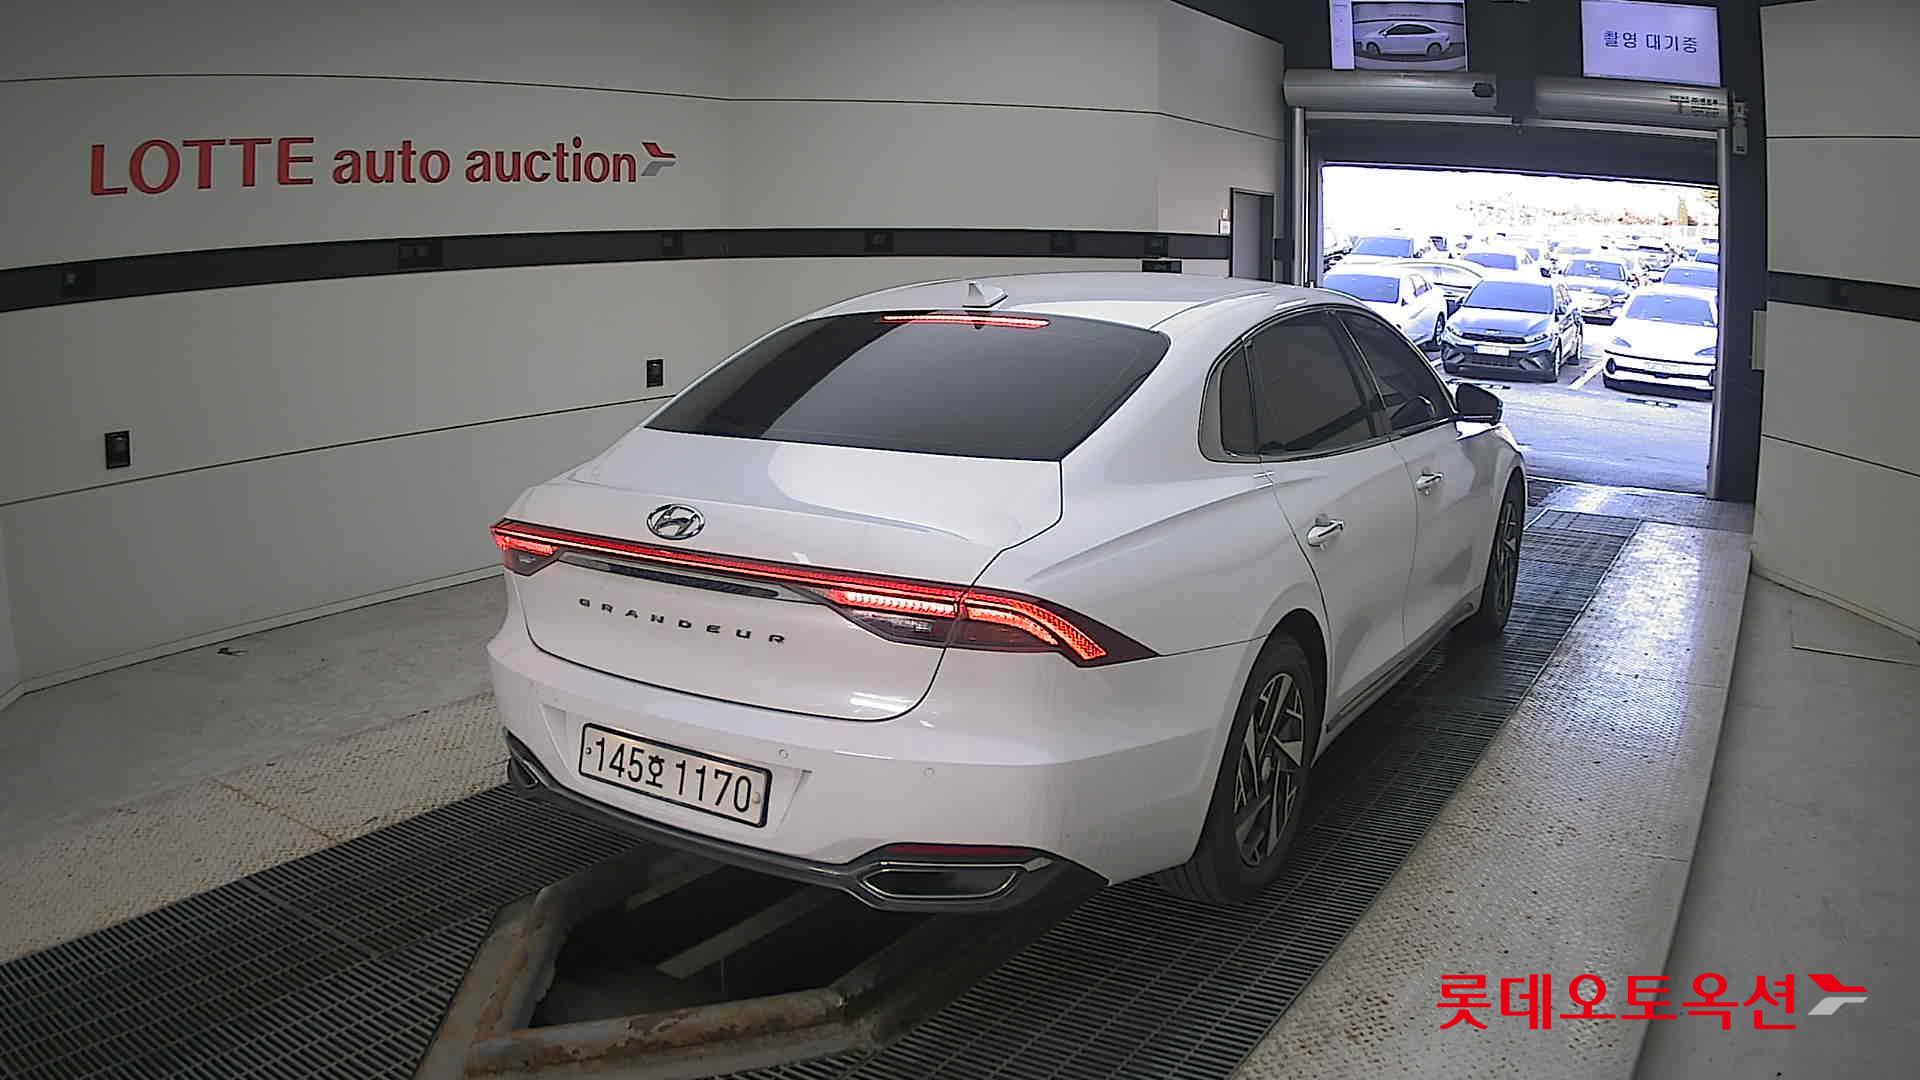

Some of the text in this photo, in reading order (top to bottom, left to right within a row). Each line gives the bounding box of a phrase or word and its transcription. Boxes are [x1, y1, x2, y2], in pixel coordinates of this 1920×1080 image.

[1604, 31, 1697, 53] 촬영 대기중
[90, 136, 637, 196] LOTTE auto auction
[579, 598, 785, 644] GRANDEUR
[595, 736, 752, 813] 145호 1170
